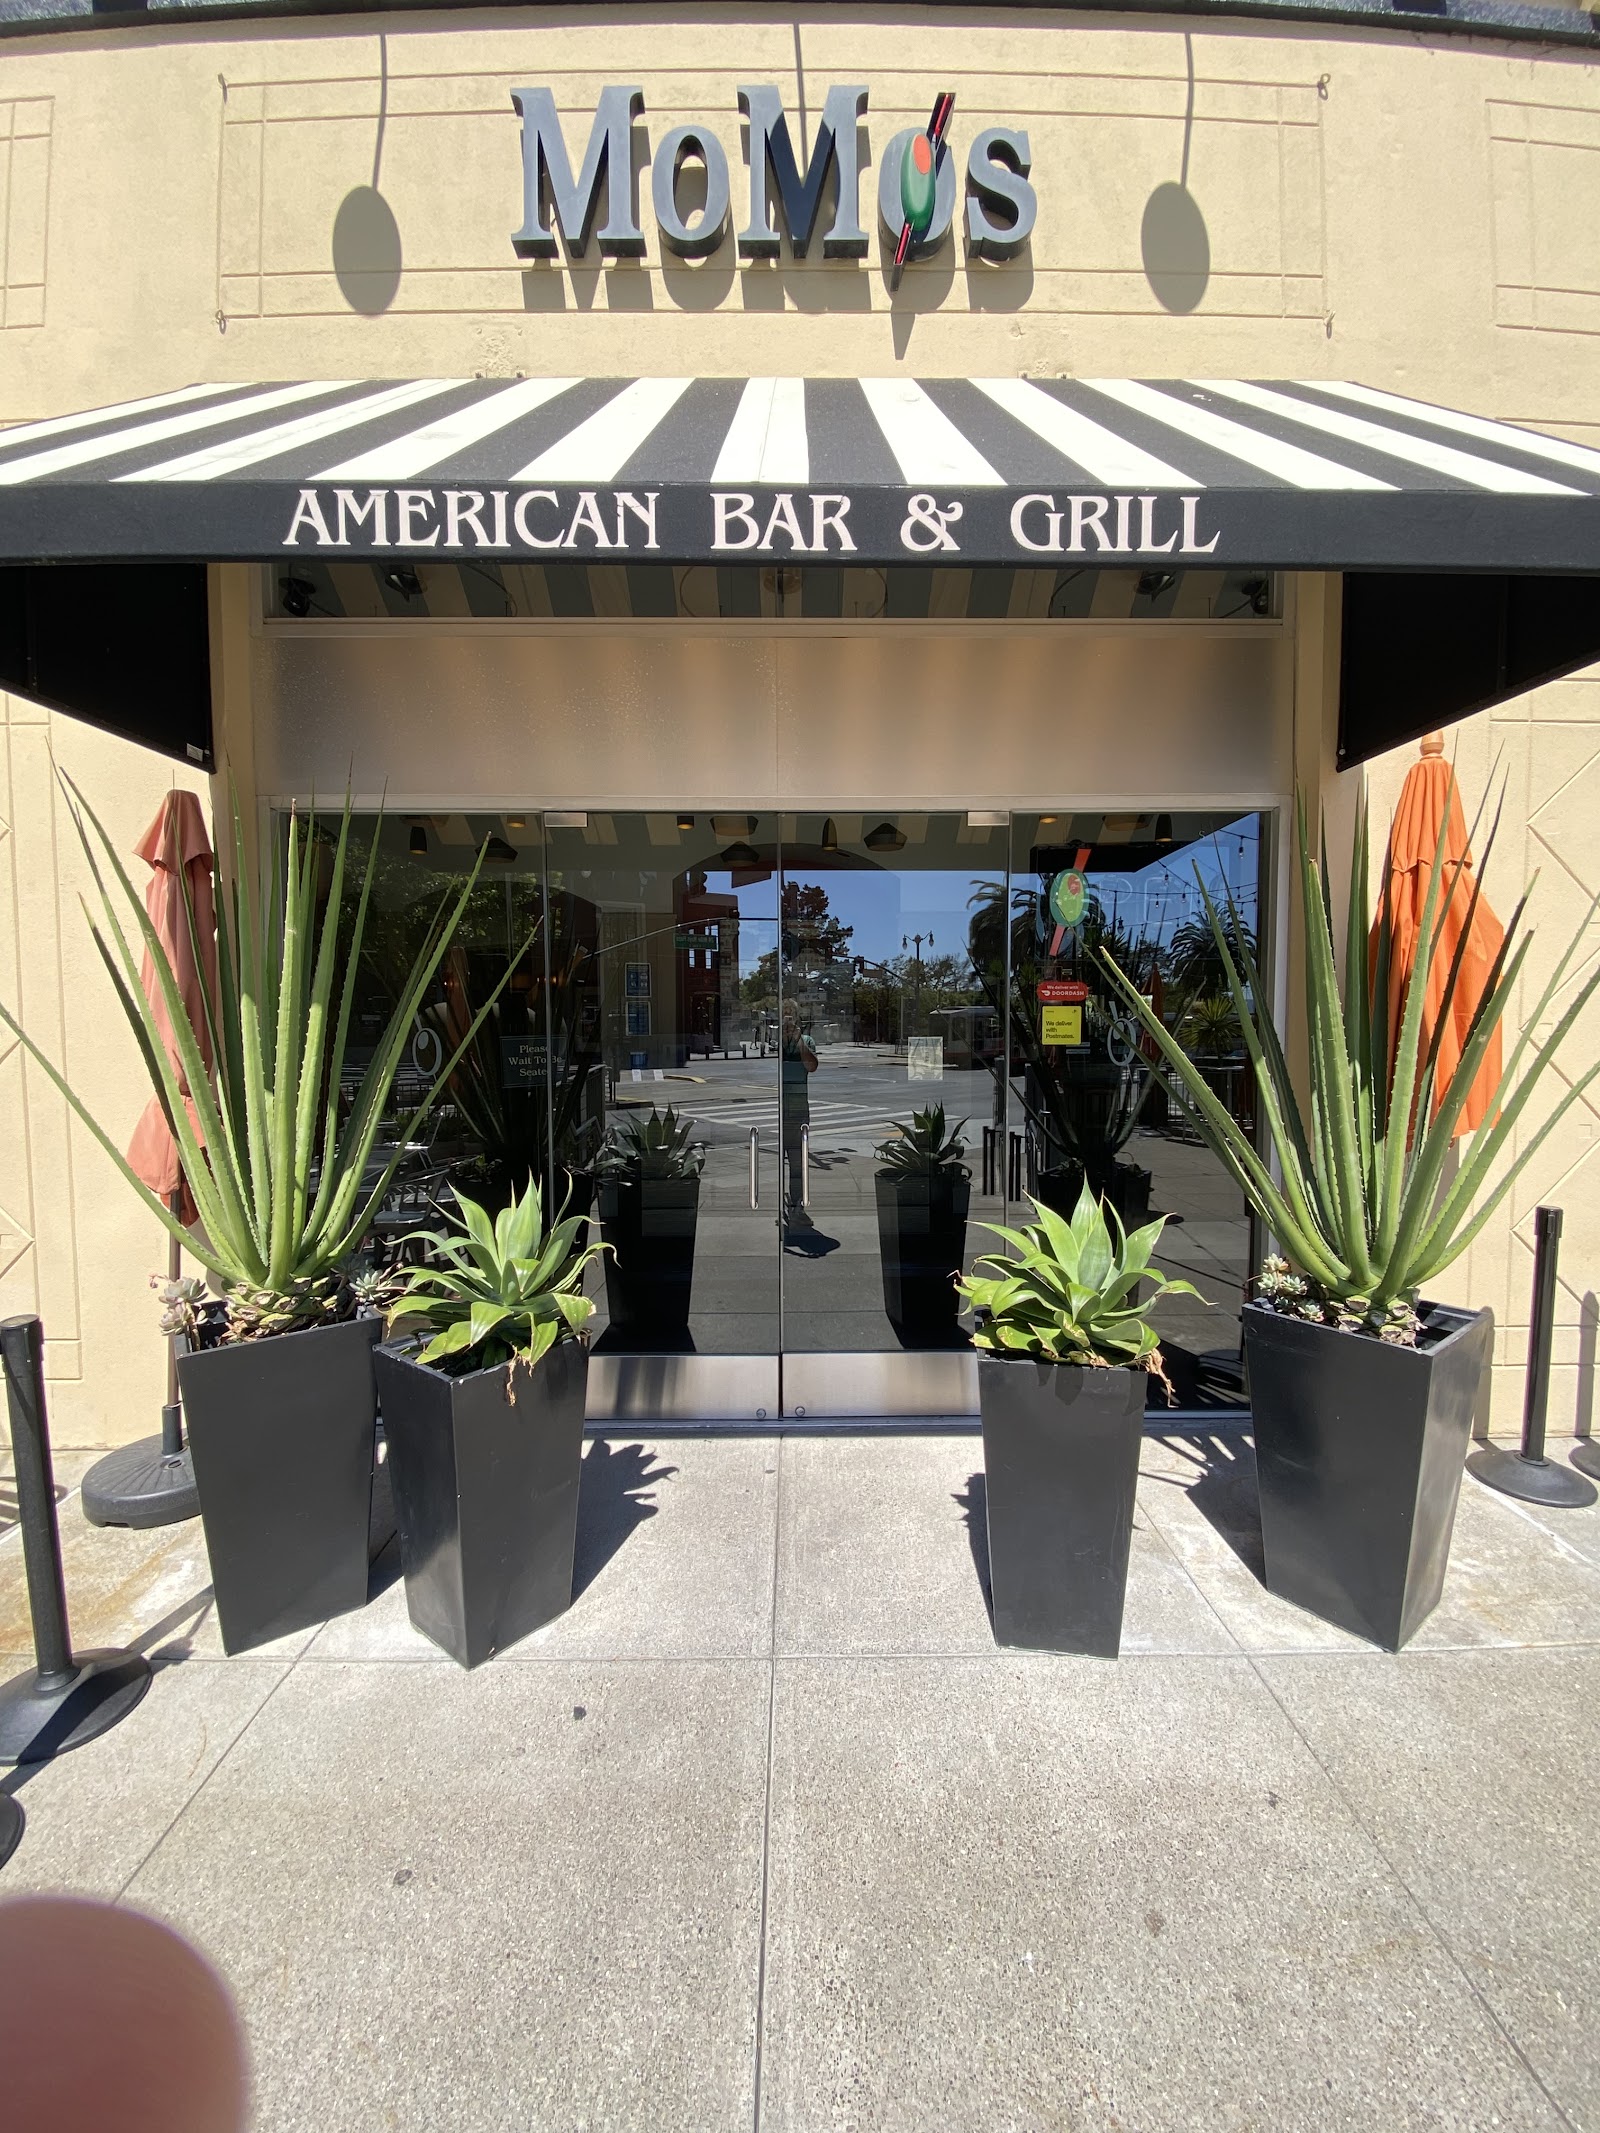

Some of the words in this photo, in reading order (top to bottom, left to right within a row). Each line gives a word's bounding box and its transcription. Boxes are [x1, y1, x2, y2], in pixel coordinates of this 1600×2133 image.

[281, 489, 661, 550] AMERICAN
[709, 493, 858, 551] BAR
[900, 494, 964, 552] &
[1010, 494, 1221, 553] GRILL
[508, 1056, 532, 1066] Wait
[533, 1055, 546, 1064] To
[520, 1068, 548, 1077] Seate
